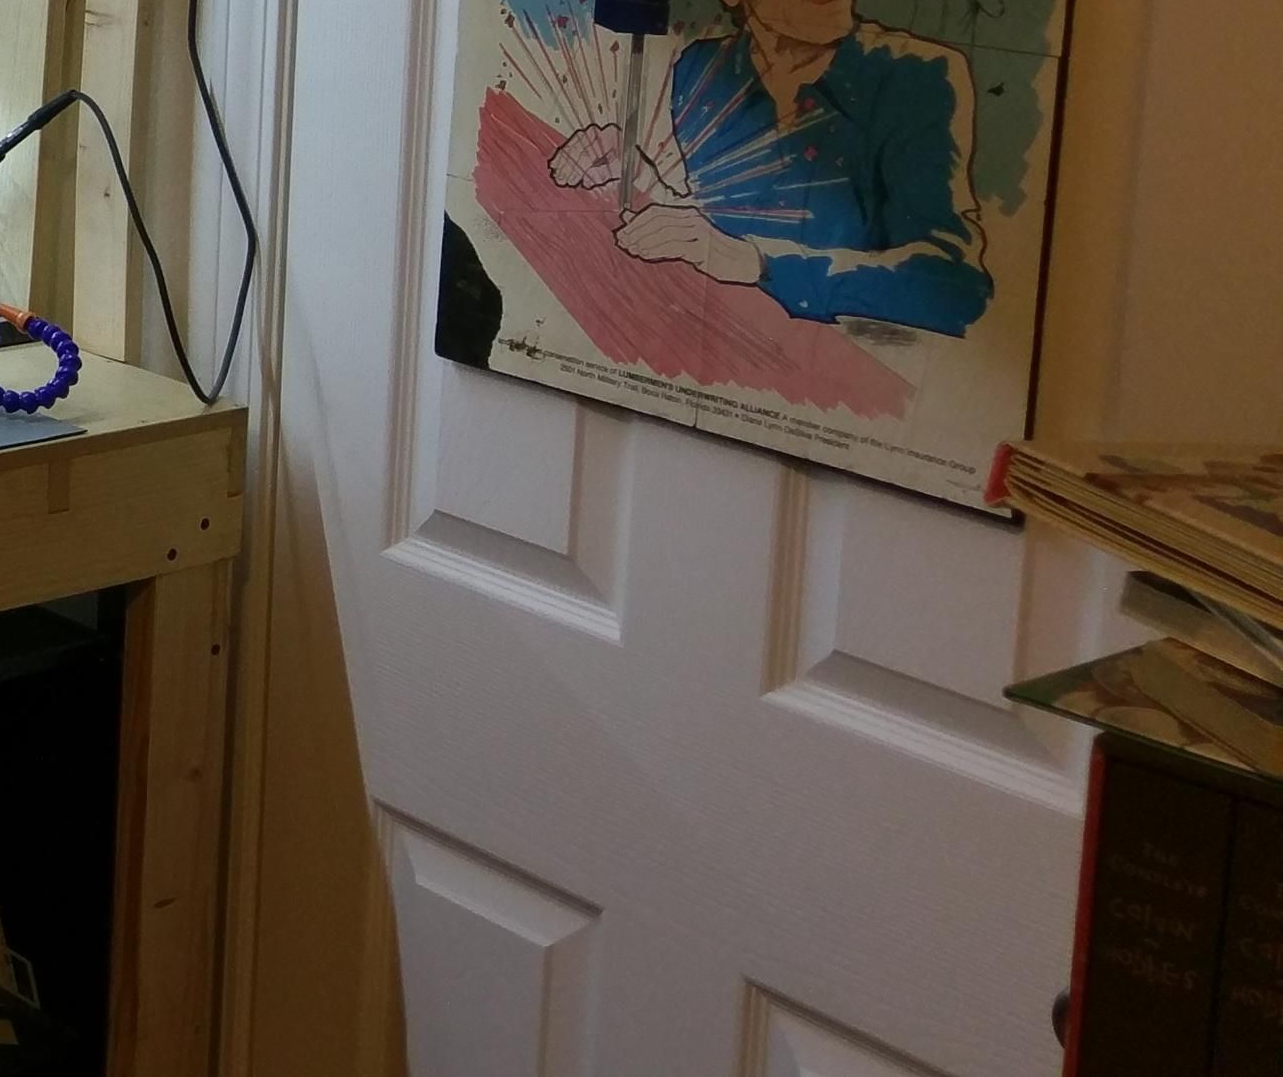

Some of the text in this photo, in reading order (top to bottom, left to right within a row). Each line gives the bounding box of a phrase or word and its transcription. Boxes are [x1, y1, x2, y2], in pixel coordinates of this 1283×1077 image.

[675, 385, 738, 409] UNDERWRITING
[740, 402, 781, 420] ALLIANCE
[948, 459, 976, 475] Group
